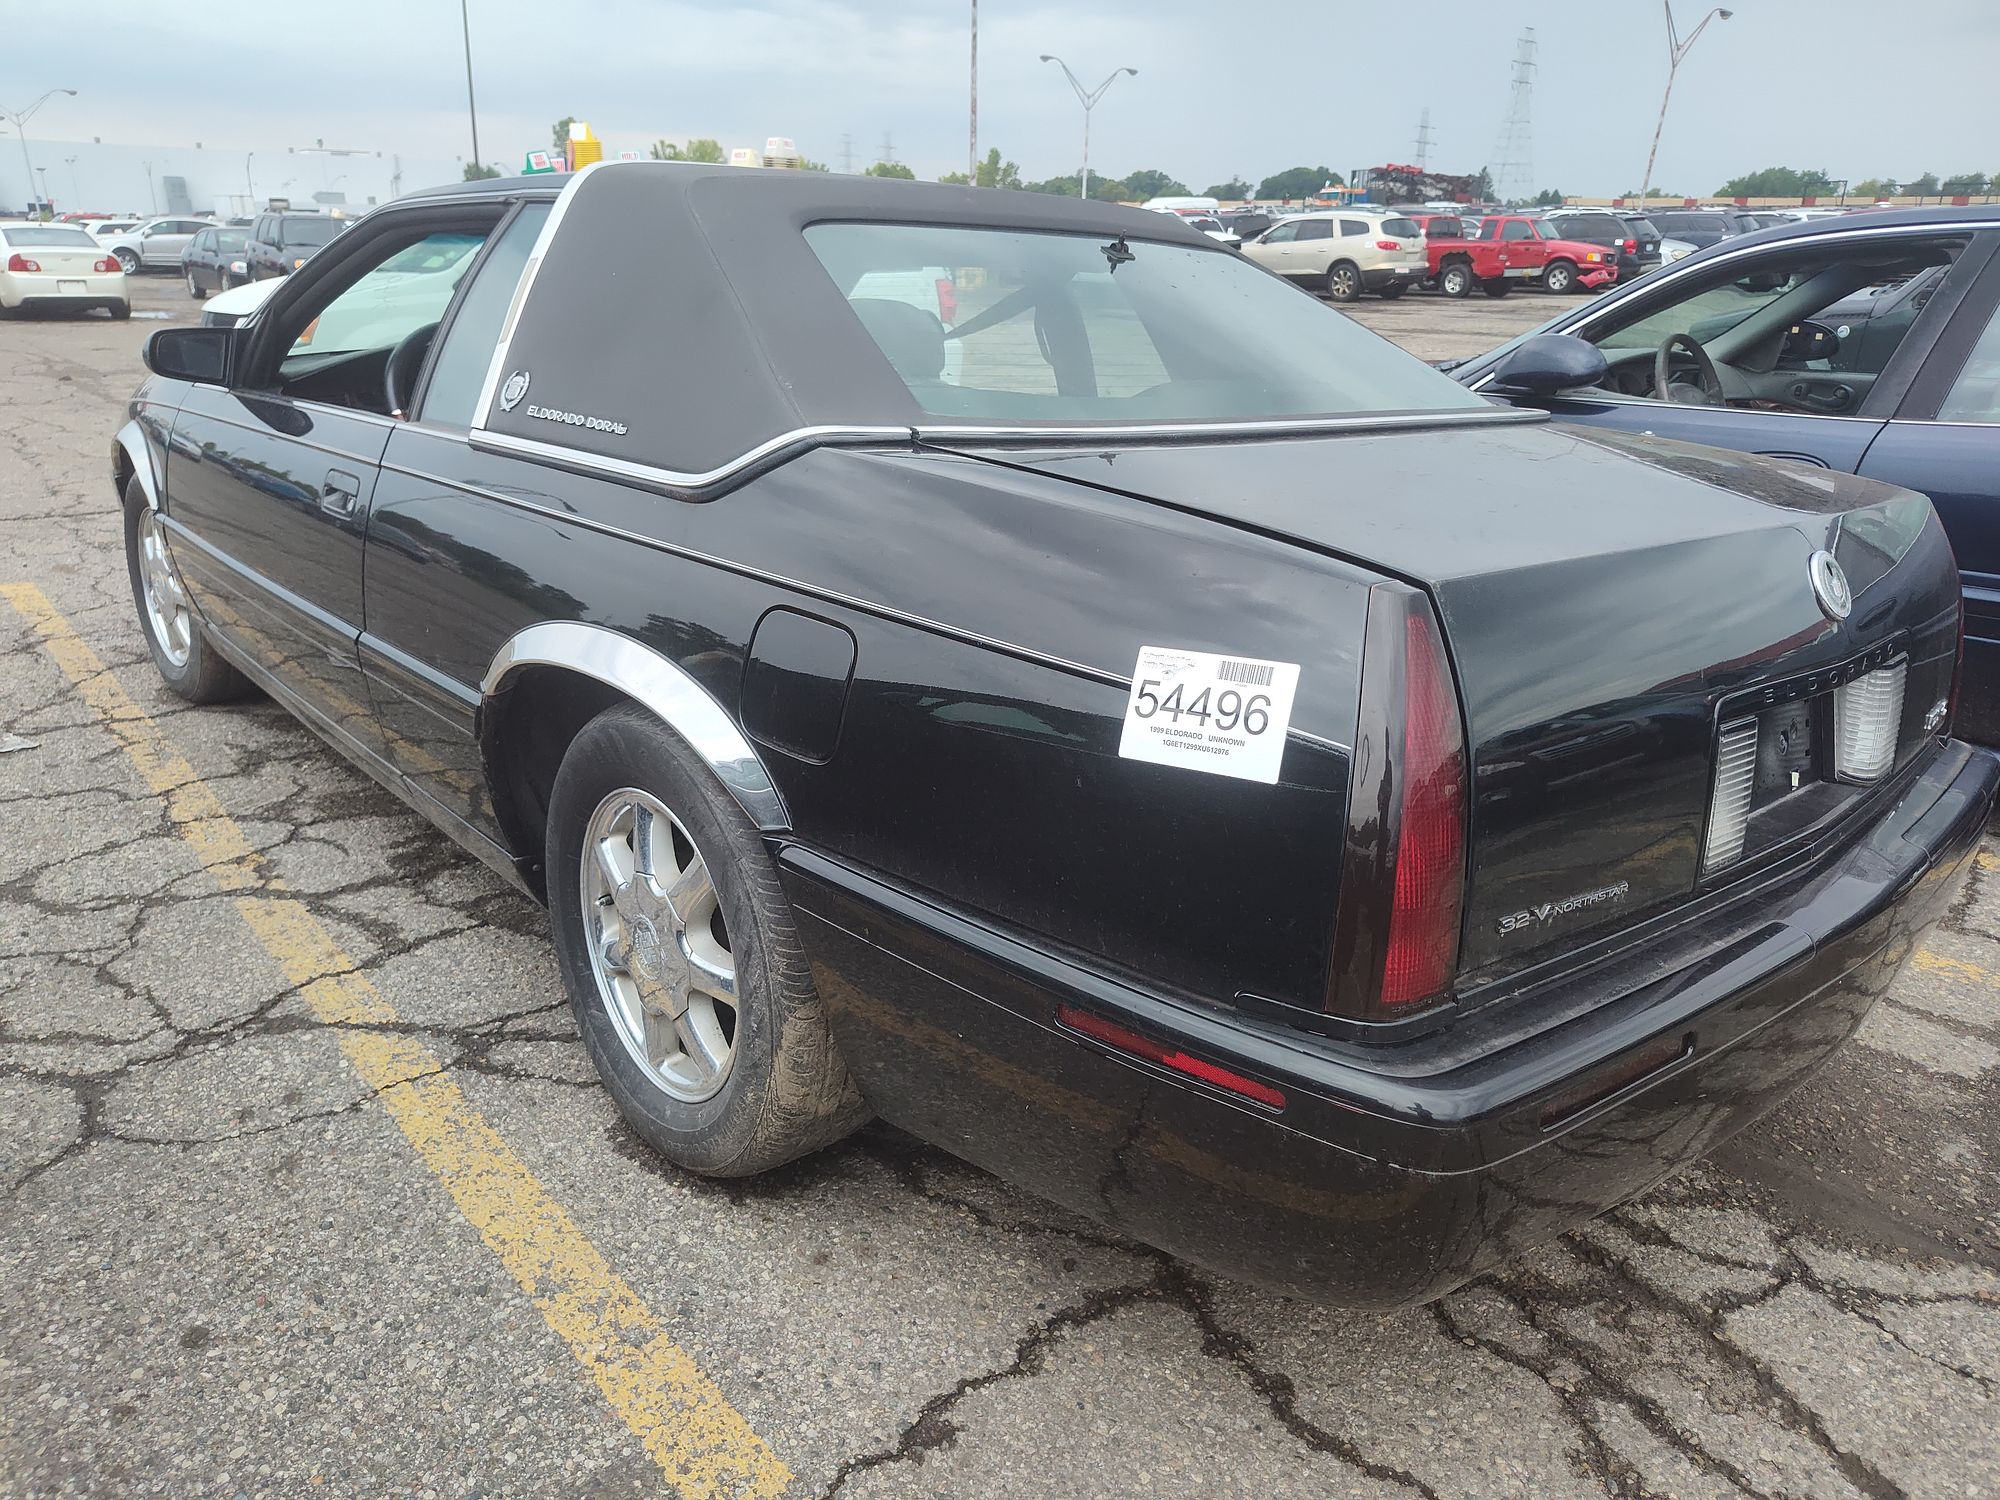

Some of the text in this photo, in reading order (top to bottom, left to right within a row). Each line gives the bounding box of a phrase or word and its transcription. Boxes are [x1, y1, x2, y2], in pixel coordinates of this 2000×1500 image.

[527, 404, 584, 426] ELDORADO
[1764, 643, 1893, 703] ELDORADO
[1134, 679, 1271, 735] 54496
[1149, 725, 1246, 747] 1999 ELDORADO UNKNOWN
[1551, 881, 1629, 916] NORTHSTAR
